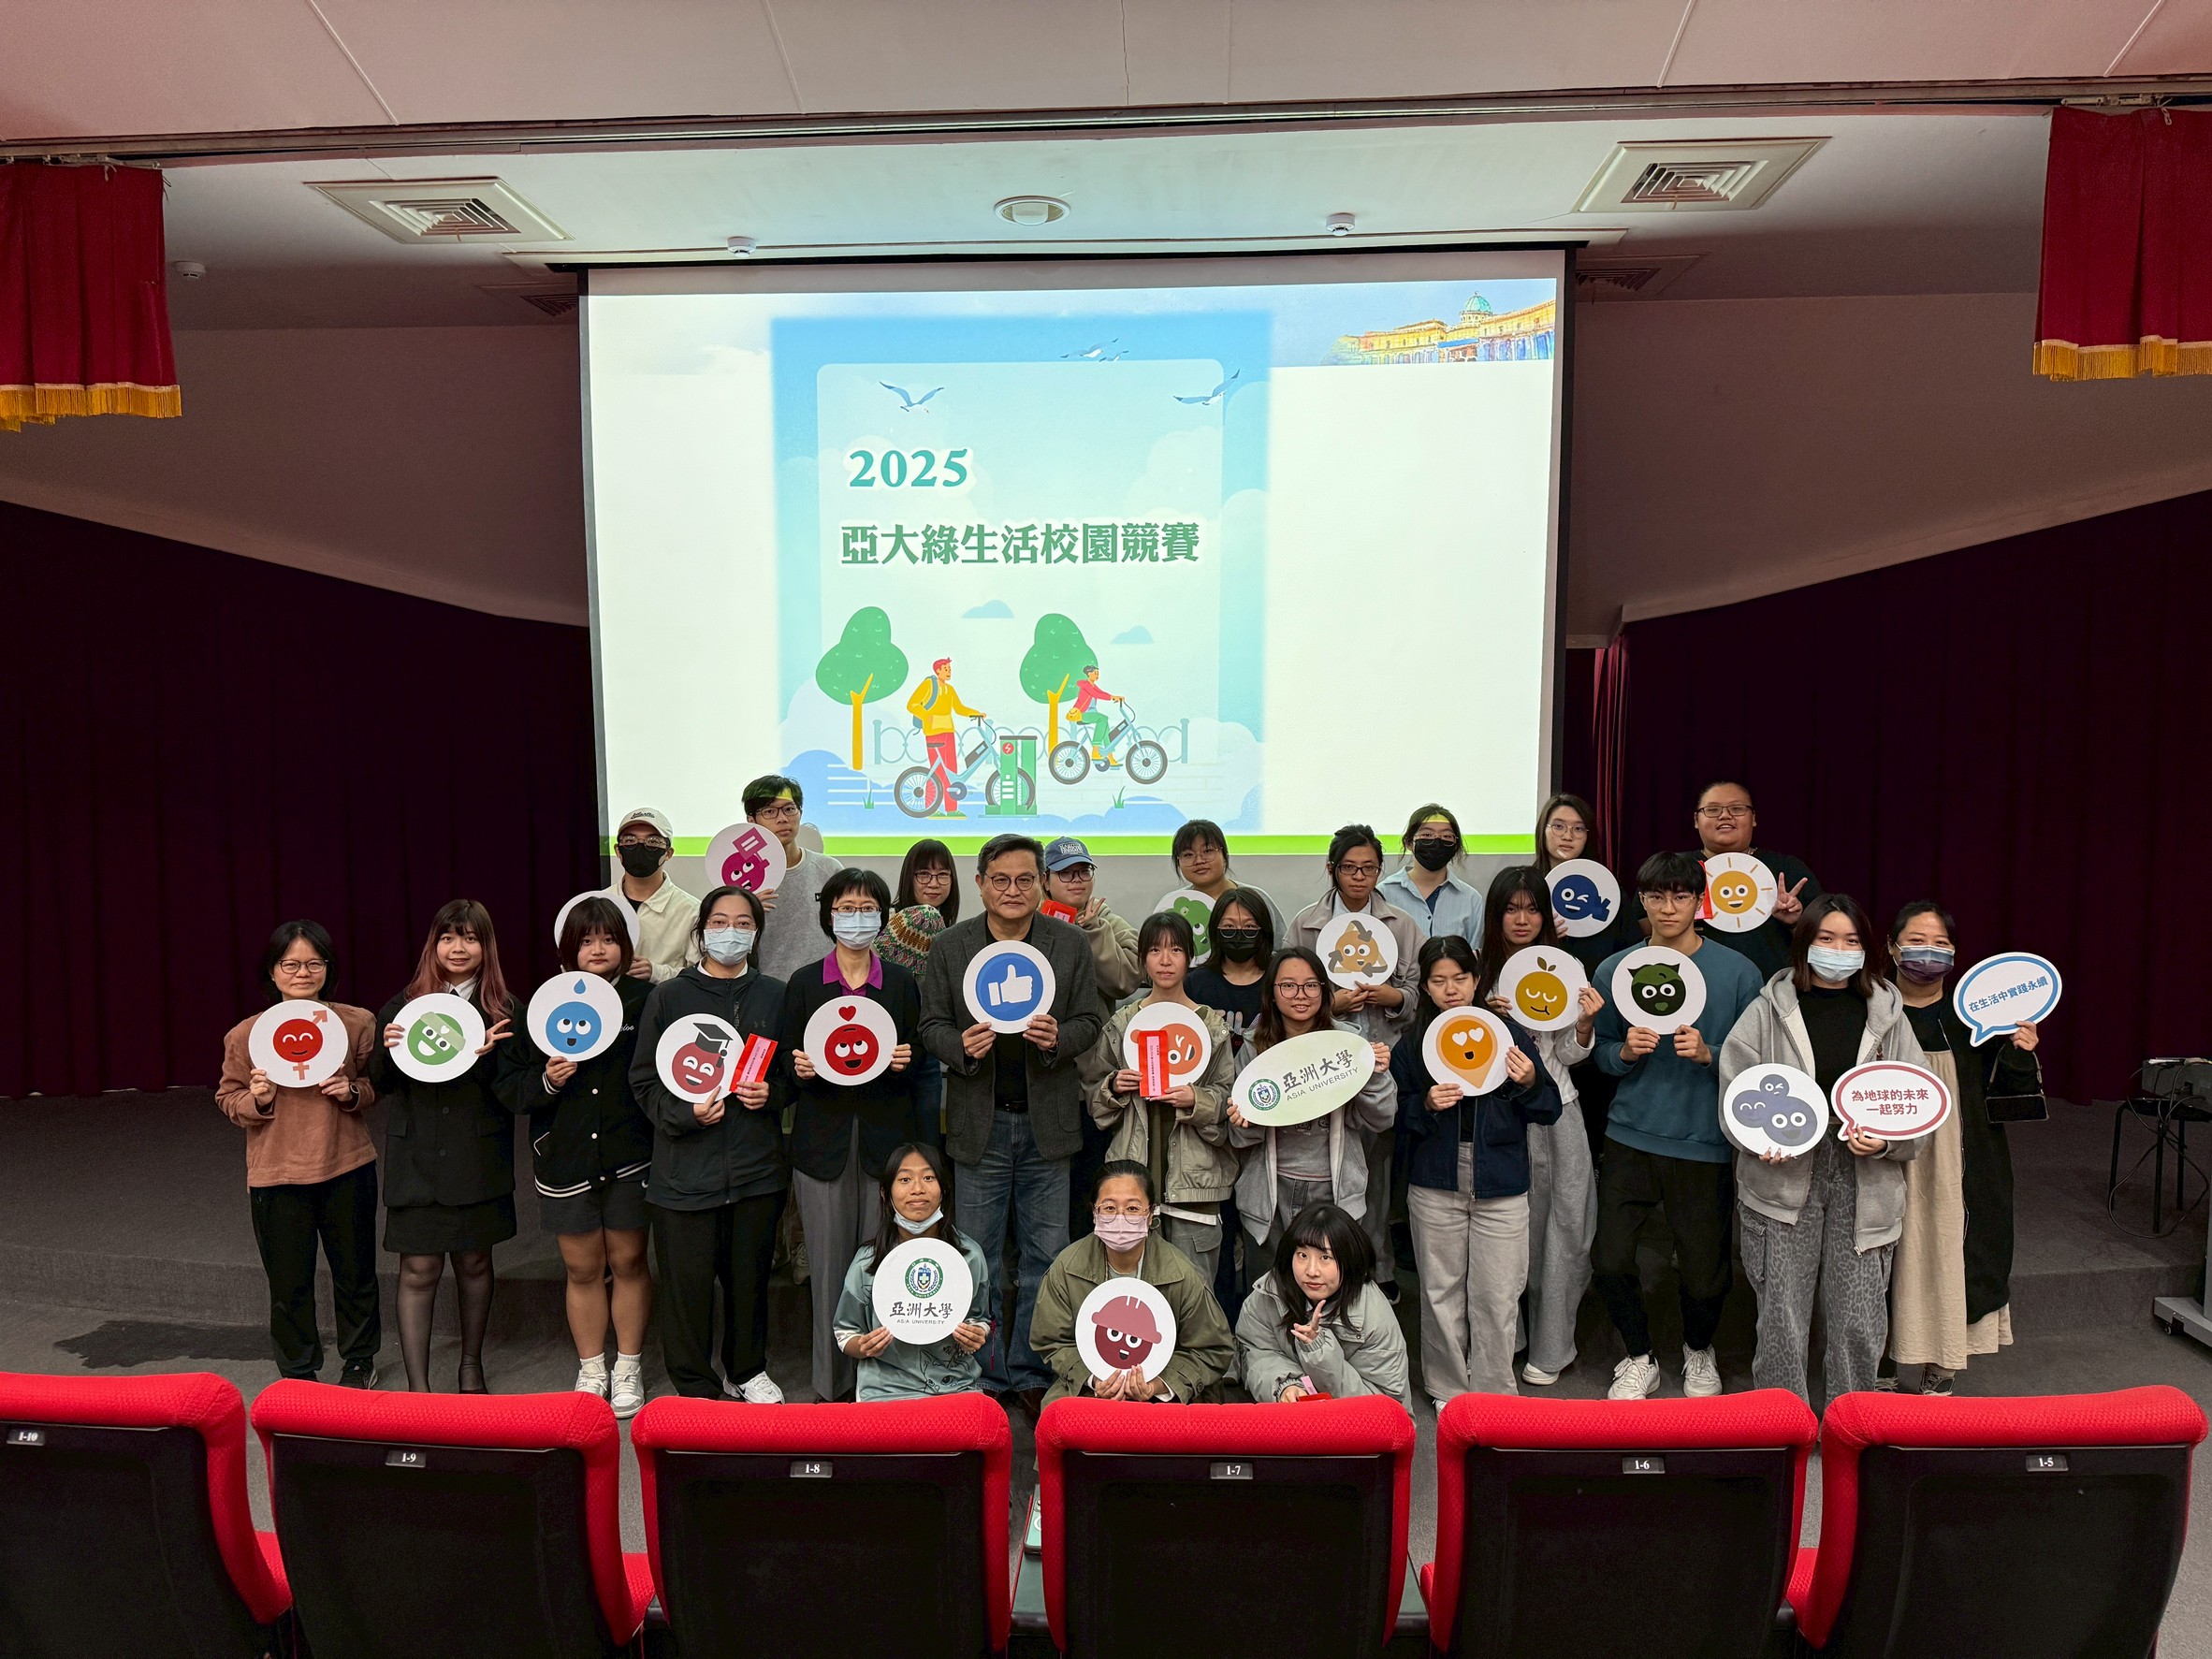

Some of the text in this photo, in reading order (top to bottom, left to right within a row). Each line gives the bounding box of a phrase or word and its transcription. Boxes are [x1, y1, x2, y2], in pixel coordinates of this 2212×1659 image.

[849, 448, 968, 488] 2025
[840, 521, 1200, 565] 亞大綠生活校園競賽
[1968, 975, 2049, 1012] 在生活中實踐永續
[1282, 1049, 1353, 1093] 亞洲大學
[1287, 1067, 1359, 1101] ASIA UNIVERSITY
[1851, 1088, 1929, 1102] 為地球的未來
[1866, 1103, 1918, 1115] 一起努力
[889, 1301, 953, 1319] 亞洲大學
[18, 1432, 38, 1442] 1-10
[401, 1452, 416, 1463] 1-9
[2038, 1457, 2054, 1467] 1-5
[805, 1463, 821, 1474] 1-8
[1226, 1465, 1242, 1476] 1-7
[1635, 1460, 1650, 1470] 1-6
